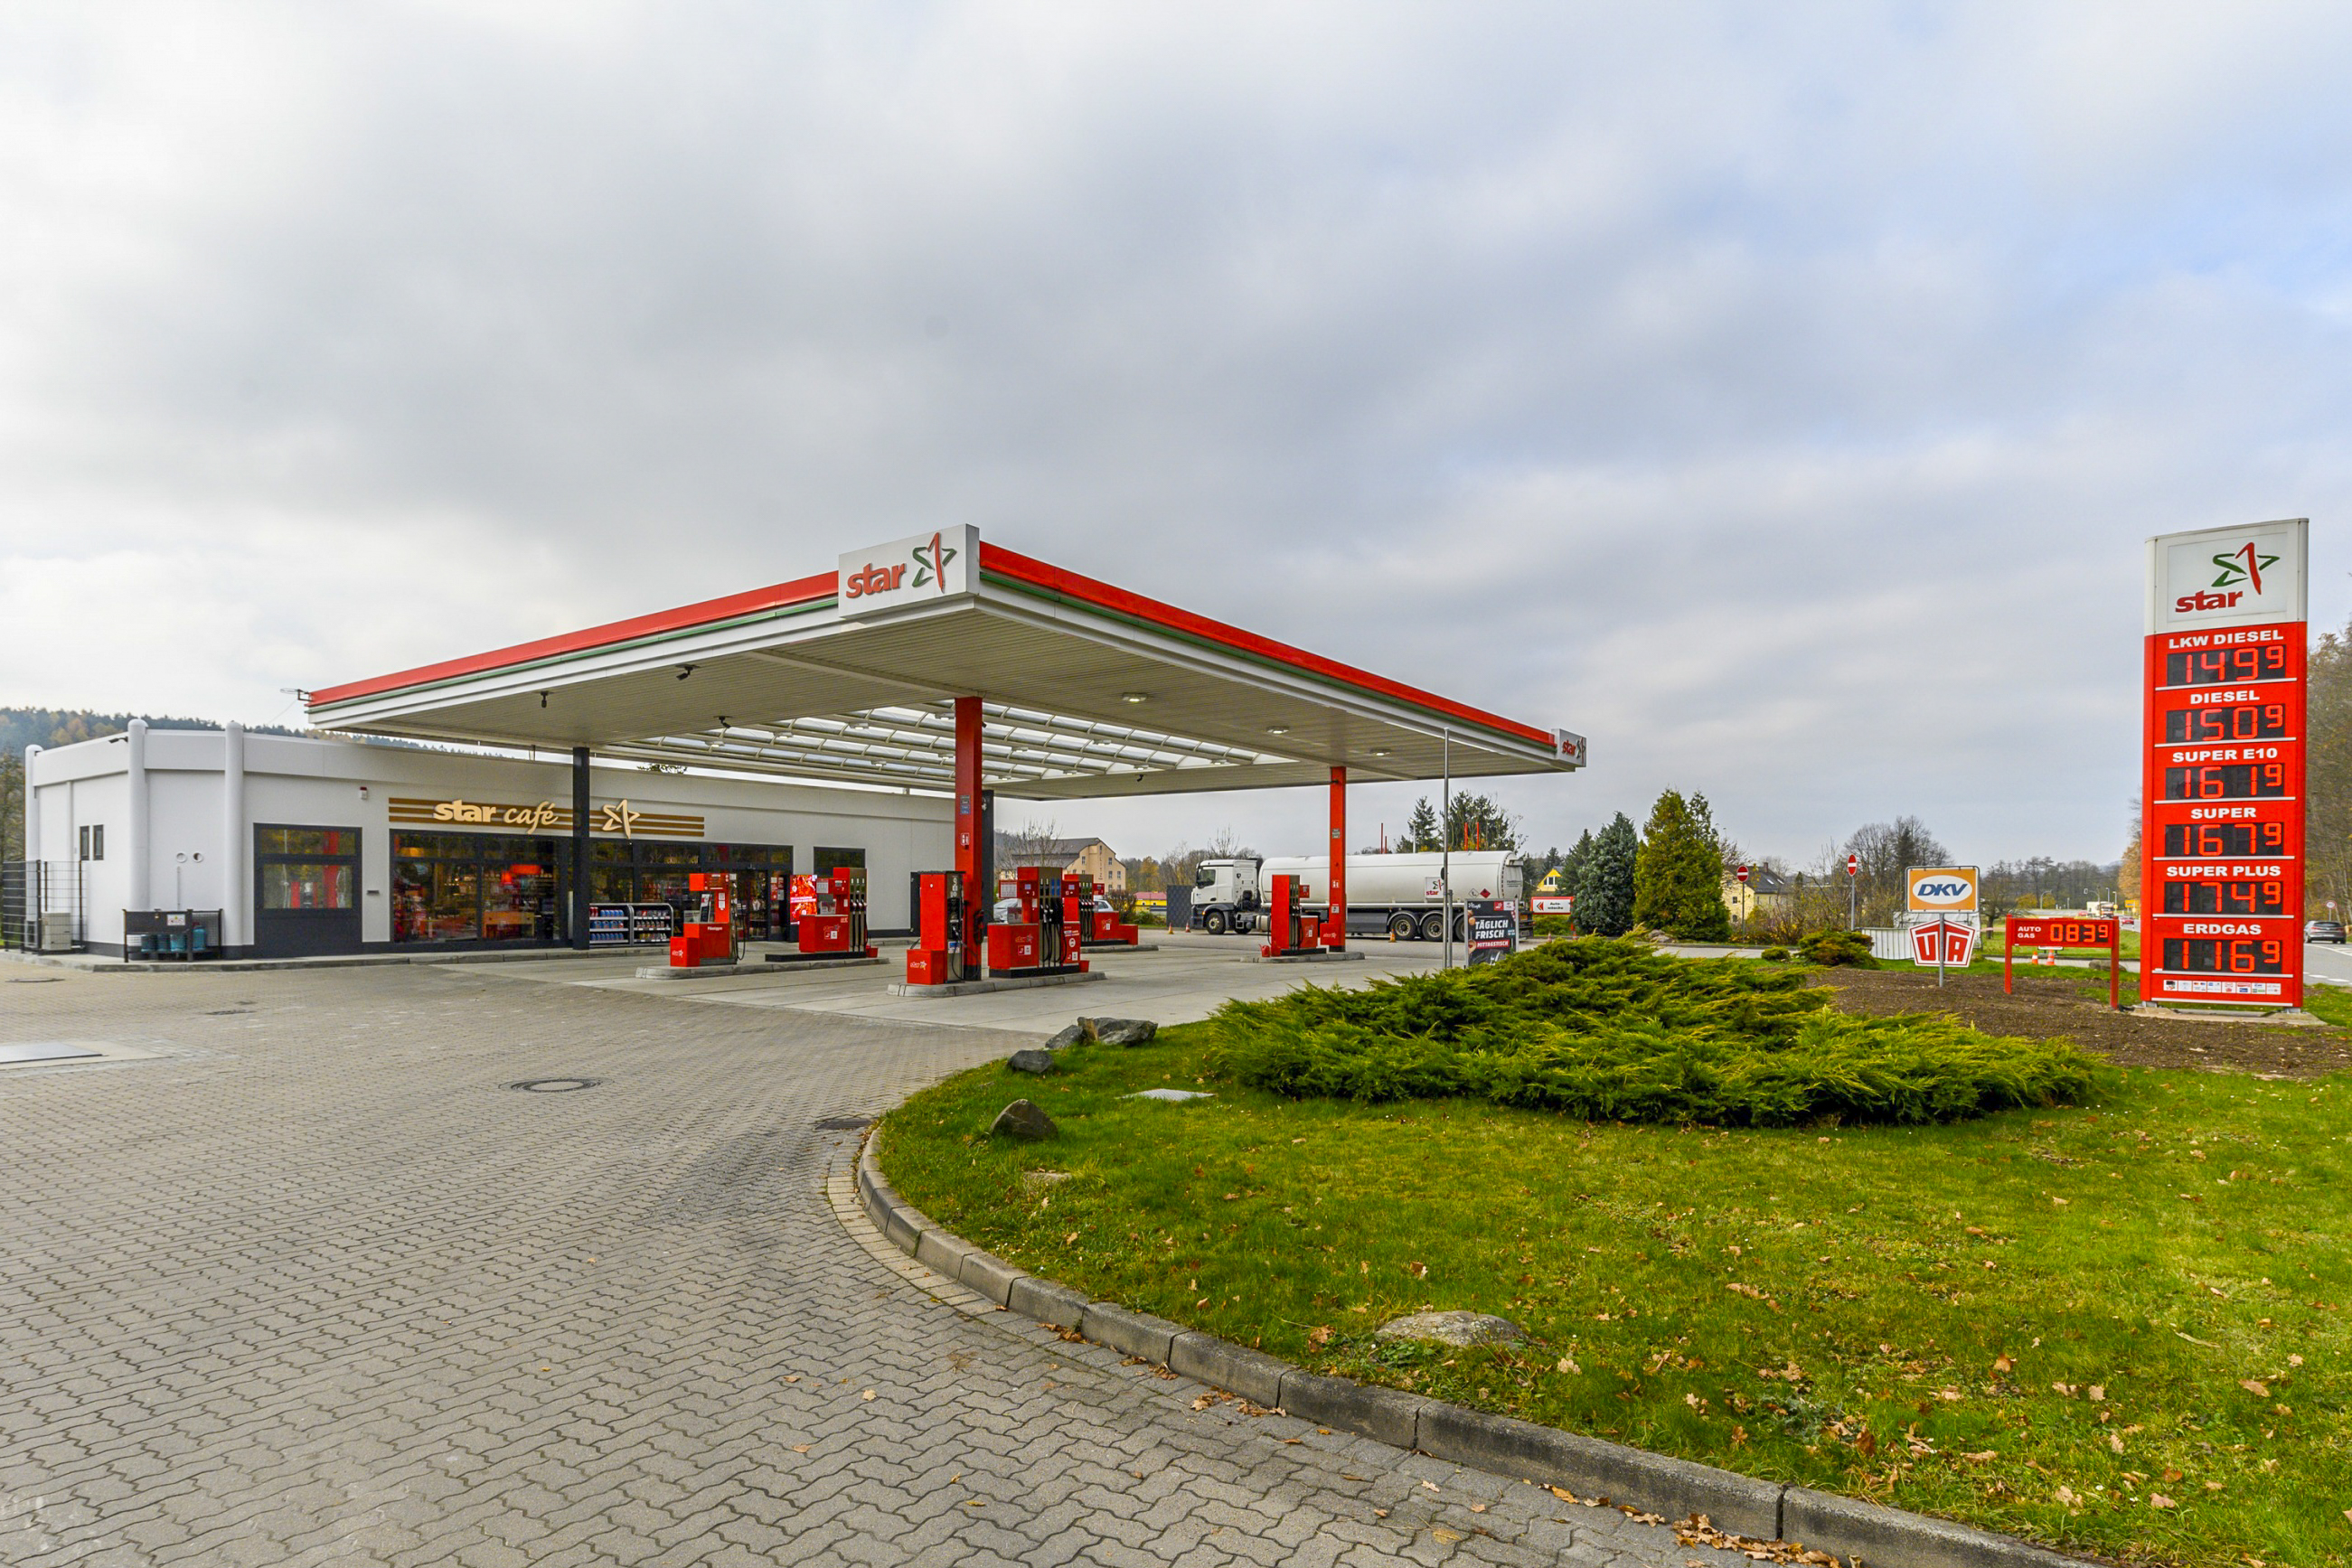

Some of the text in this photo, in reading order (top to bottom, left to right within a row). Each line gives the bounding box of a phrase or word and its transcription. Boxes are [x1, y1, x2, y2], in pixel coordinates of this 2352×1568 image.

[846, 563, 907, 598] star
[2175, 590, 2243, 613] star
[2169, 630, 2283, 649] LKW DIESEL
[2185, 645, 2284, 683] 1499
[2190, 690, 2260, 705] DIESEL
[2185, 704, 2283, 741] 1509
[1562, 739, 1576, 756] star
[2172, 748, 2278, 763] SUPER E10
[2184, 764, 2282, 799] 1619
[433, 799, 559, 834] star café
[2190, 807, 2256, 819] SUPER
[2183, 822, 2281, 856] 1679
[2167, 865, 2281, 878] SUPER PLUS
[1917, 883, 1968, 897] DKV
[2183, 881, 2281, 913] 1749
[1475, 919, 1509, 929] TÄGLICH
[2049, 924, 2109, 943] 0839
[2183, 924, 2262, 935] ERDGAS
[1475, 929, 1505, 939] FRISCH
[2182, 940, 2281, 973] 1169
